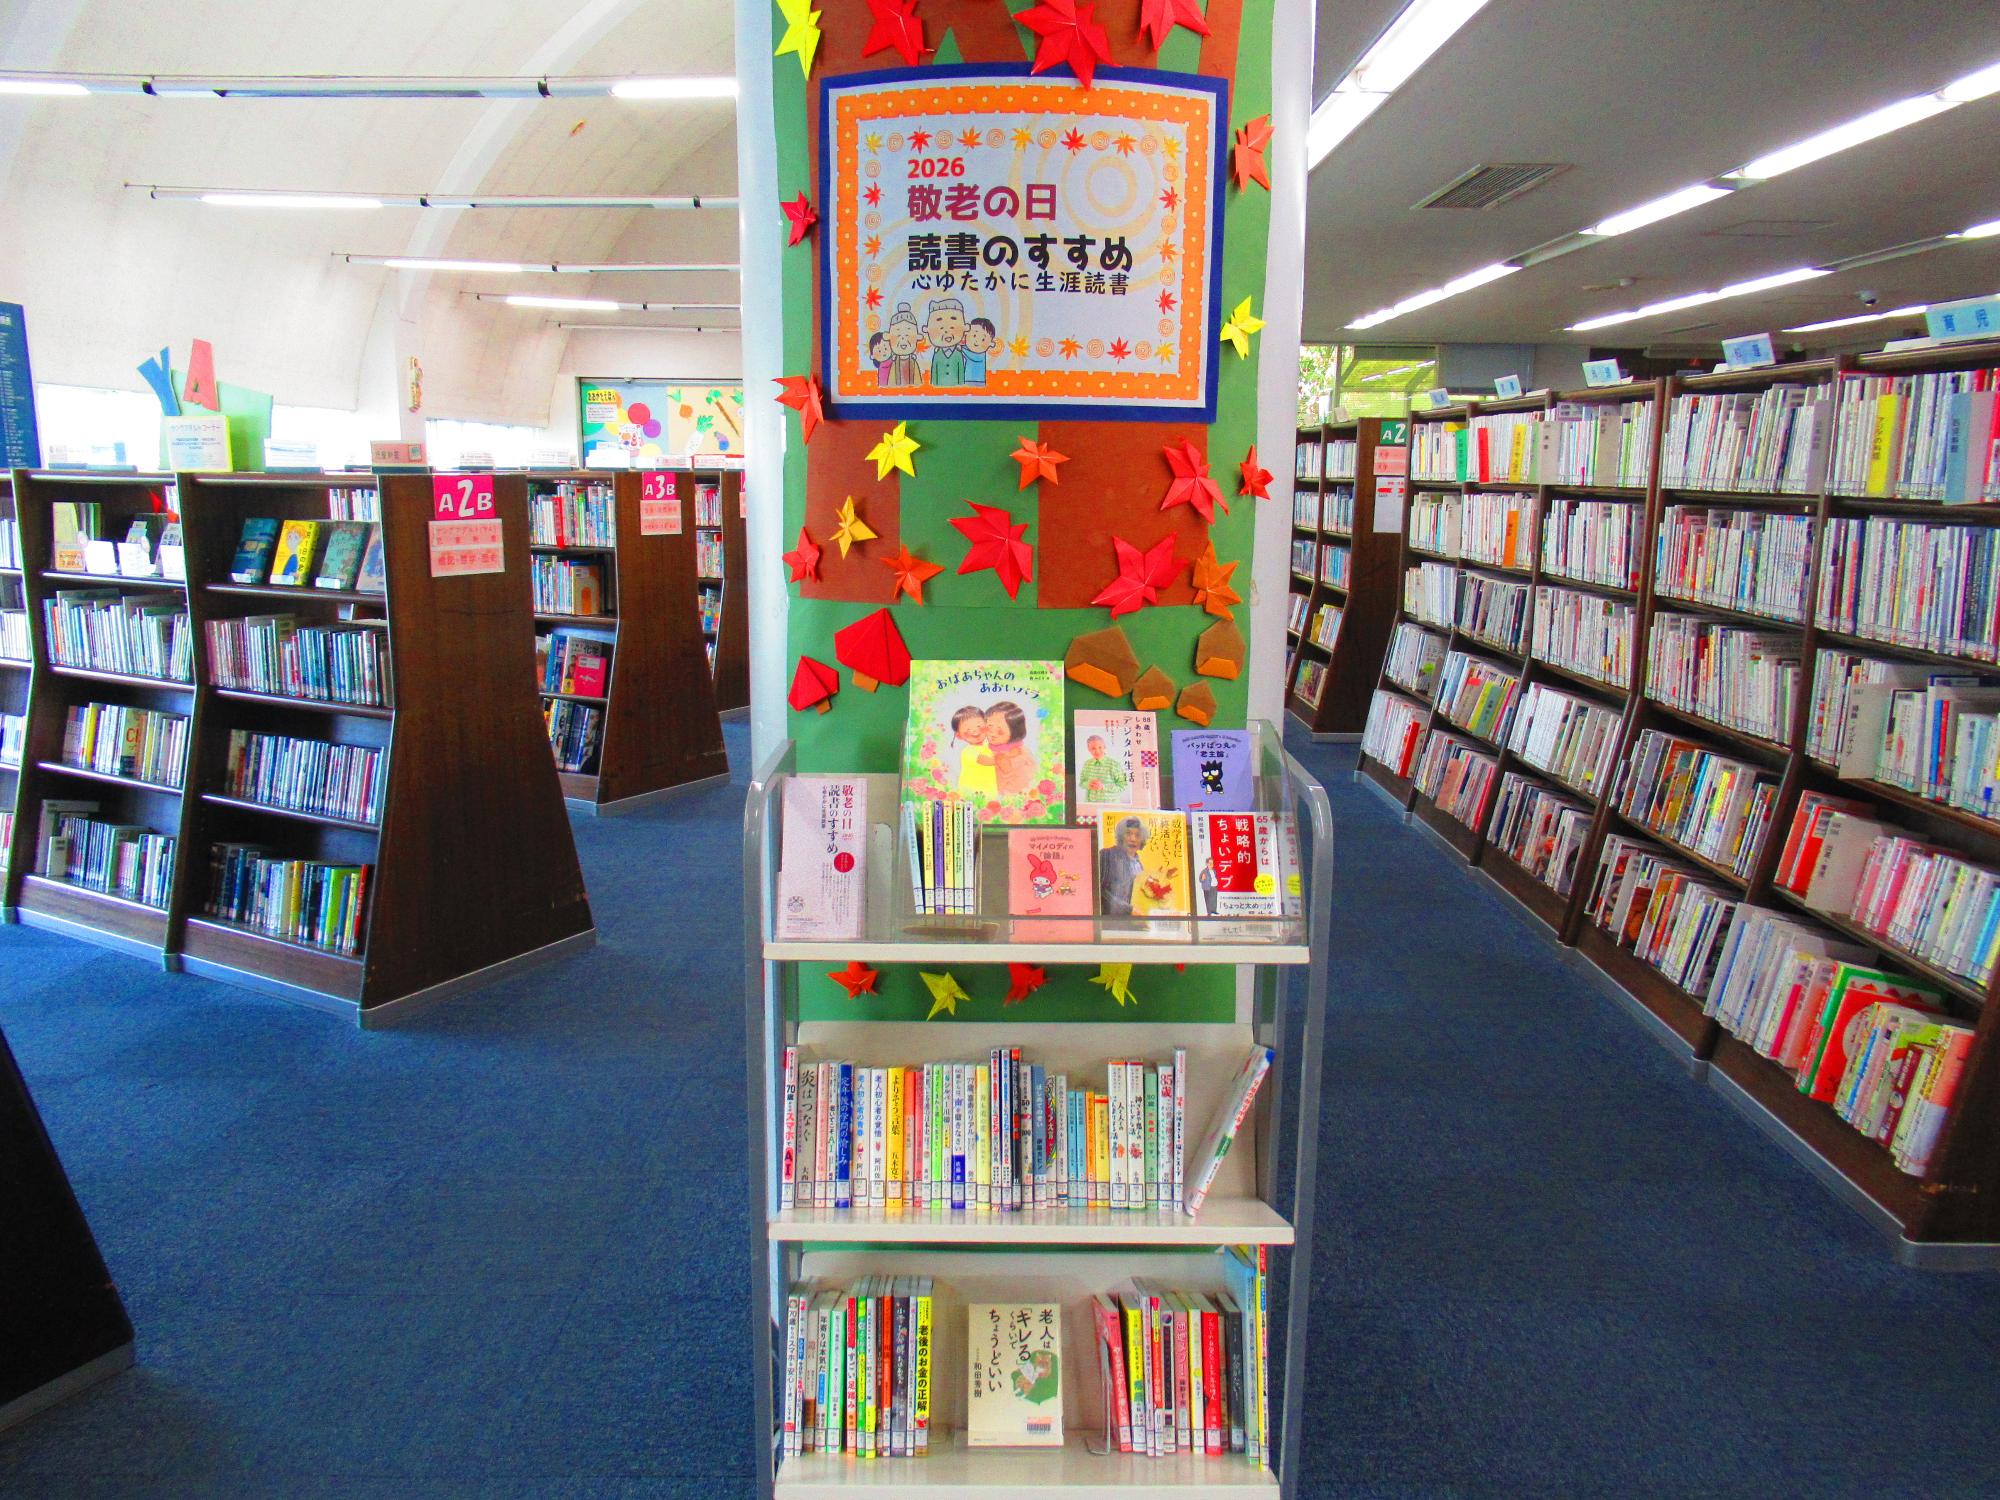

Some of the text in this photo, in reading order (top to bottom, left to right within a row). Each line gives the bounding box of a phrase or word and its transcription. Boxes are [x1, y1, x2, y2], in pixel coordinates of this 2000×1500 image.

[908, 157, 965, 178] 2026
[908, 183, 1056, 221] 敬老の日
[908, 233, 1132, 272] 読書のすすめ
[912, 271, 1129, 296] 心ゆたかに生涯読書
[438, 479, 493, 518] A2B
[645, 475, 676, 499] A3B
[936, 669, 1015, 690] おばあちゃんの
[980, 682, 1040, 699] あおいバラ
[1123, 716, 1135, 783] デジタル生活
[827, 784, 840, 854] 読書のすすめ
[842, 784, 854, 829] 敬老の日
[1028, 842, 1074, 850] マイメロディの
[1217, 818, 1233, 888] ちょいデブ
[1235, 818, 1250, 864] 戦略的
[1257, 815, 1268, 865] 65歳からは
[801, 1070, 815, 1142] 炎はつなぐ
[892, 1074, 900, 1136] よりそう言葉
[989, 1308, 1002, 1392] ちょうどいい
[1016, 1307, 1033, 1366] 「キレる」
[1040, 1309, 1054, 1348] 老人は
[917, 1325, 929, 1411] 老後のお金の正解
